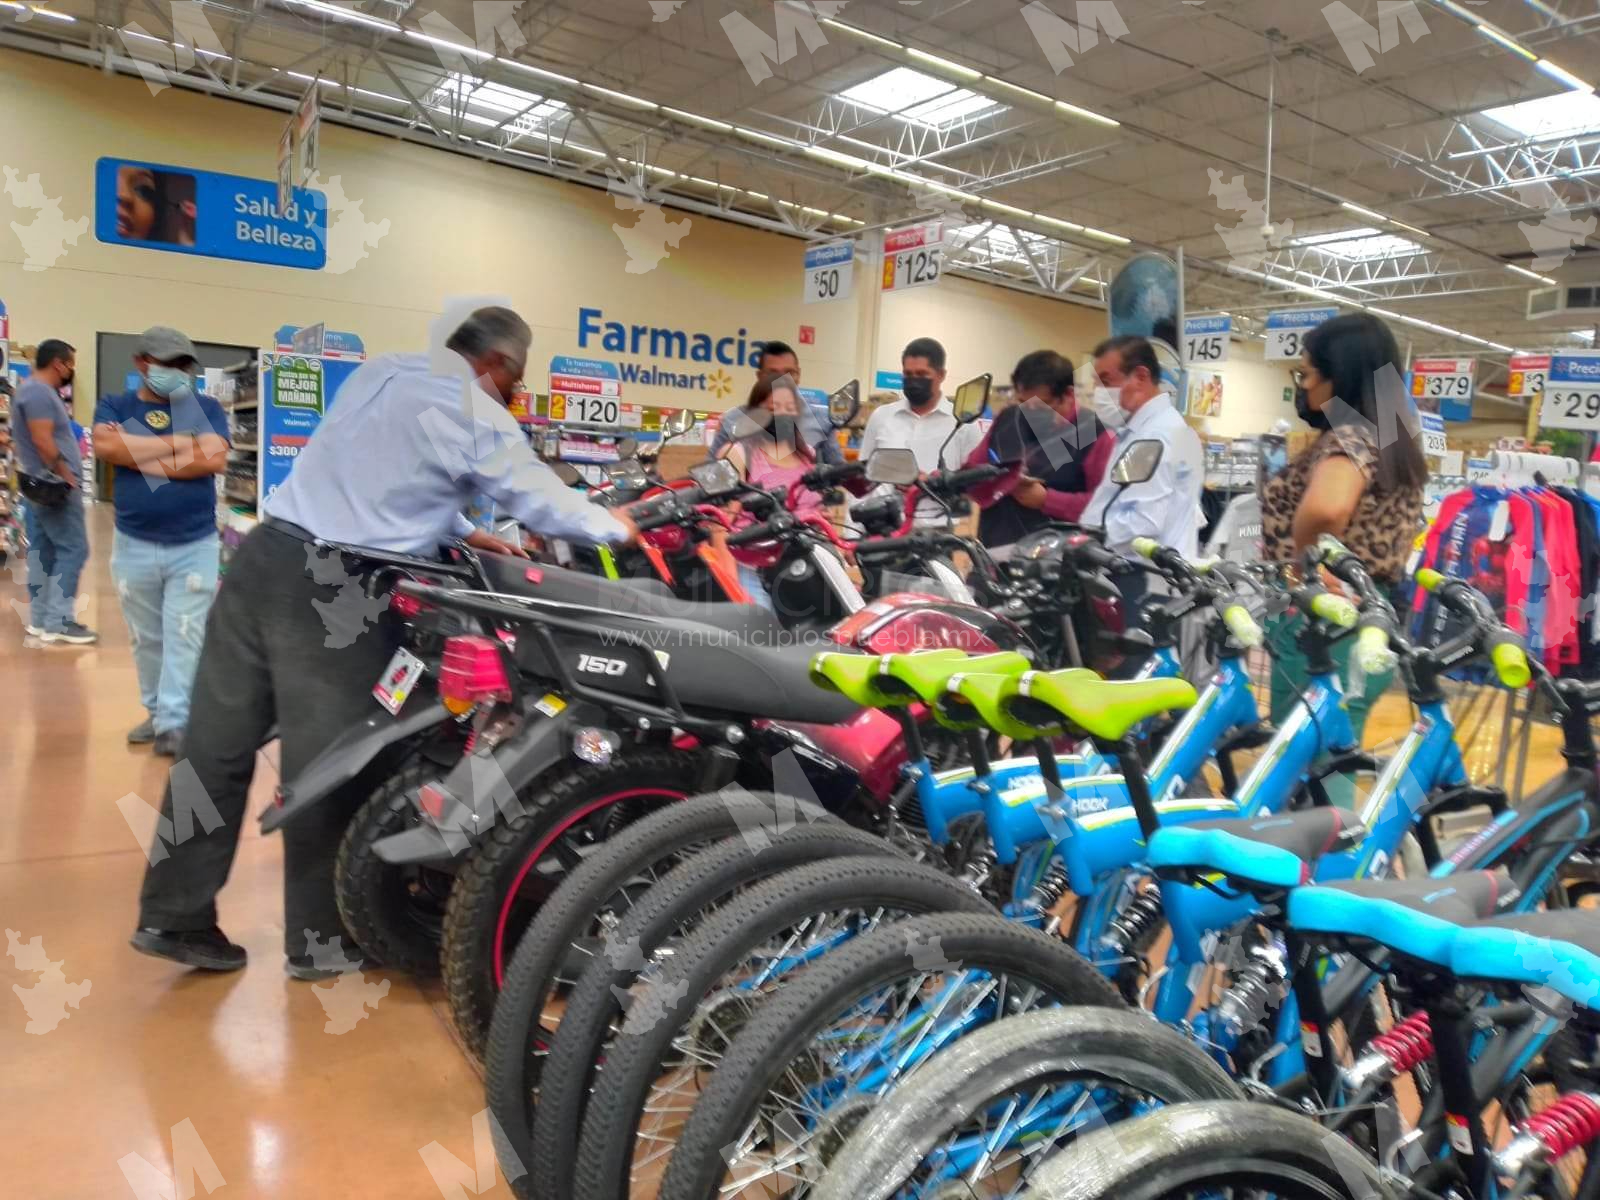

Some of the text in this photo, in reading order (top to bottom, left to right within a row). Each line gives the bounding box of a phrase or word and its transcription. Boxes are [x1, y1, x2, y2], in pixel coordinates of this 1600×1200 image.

[234, 193, 317, 229] Salud y
[236, 220, 317, 251] Belleza
[897, 249, 940, 285] $125
[814, 269, 839, 298] $50
[578, 307, 771, 368] Farmacia
[1188, 337, 1222, 360] 145
[278, 378, 318, 392] MEJOR
[619, 363, 707, 391] Walmart
[1427, 376, 1469, 396] $379
[278, 389, 318, 405] MAÑANA
[567, 396, 617, 423] $120
[577, 653, 628, 676] 150
